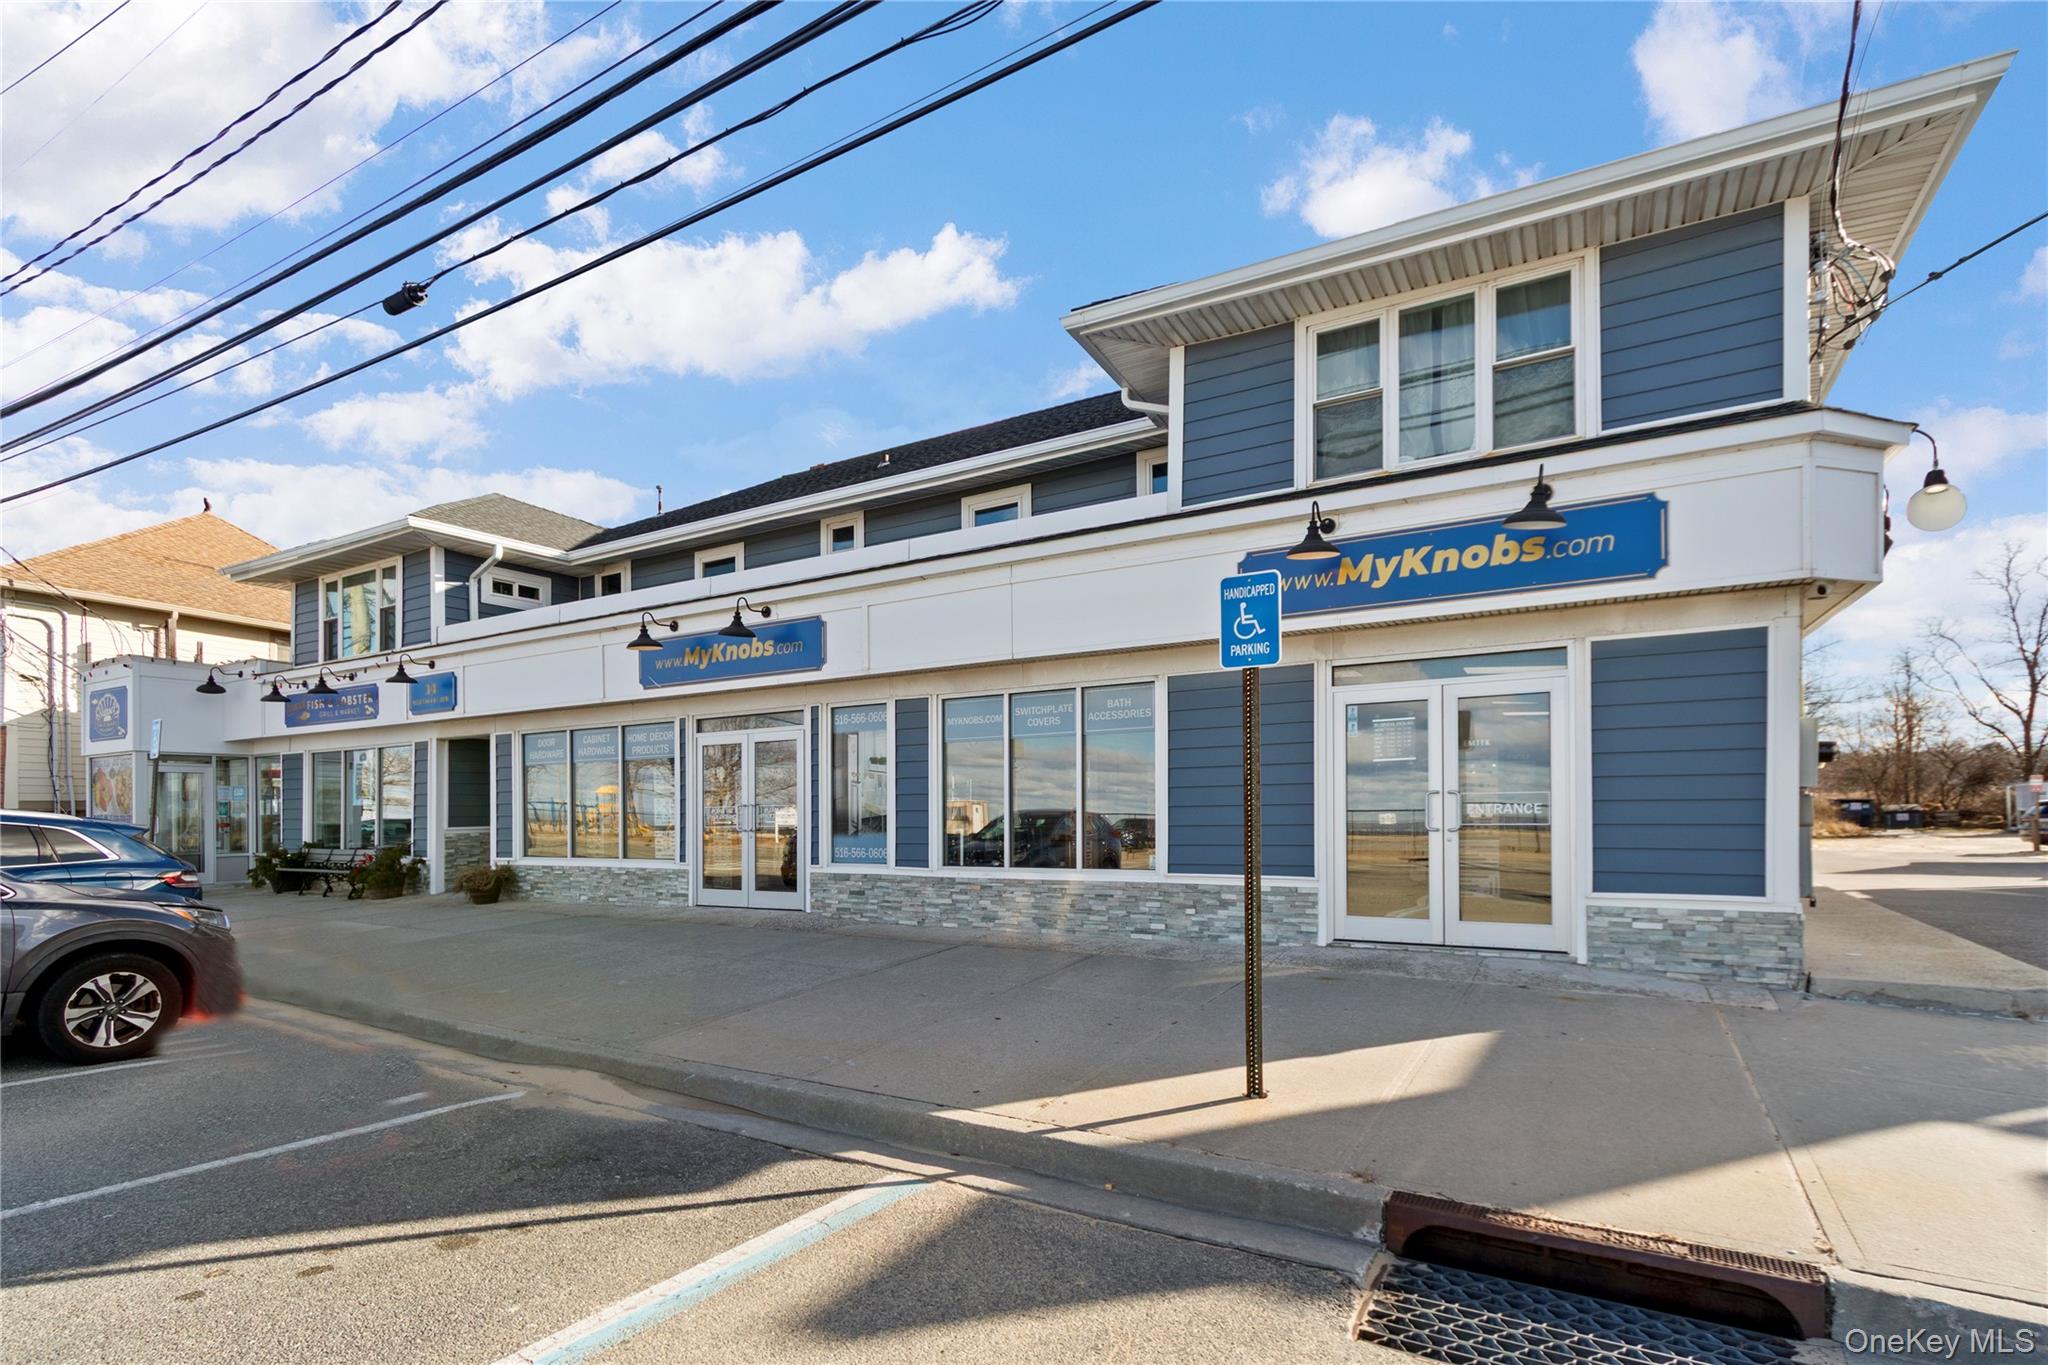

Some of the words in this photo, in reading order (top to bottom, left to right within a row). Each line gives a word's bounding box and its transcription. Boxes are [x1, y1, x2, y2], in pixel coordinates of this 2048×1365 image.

[1224, 583, 1275, 600] HANDICAPPED
[655, 637, 803, 670] www.MyKnobs.com
[1230, 642, 1270, 657] PARKING
[1107, 698, 1132, 708] BATH
[1015, 703, 1073, 717] SWITCHPLATE
[1088, 708, 1152, 722] ACCESSORIES
[946, 714, 1003, 726] MYKNOBS.COM
[1027, 716, 1060, 728] COVERS
[582, 734, 610, 745] CABINET
[627, 732, 647, 744] HOME
[529, 749, 564, 760] HARDWARE
[578, 745, 616, 758] HARDWARE
[631, 744, 669, 756] PRODUCTS
[1467, 803, 1543, 815] ENTRANCE
